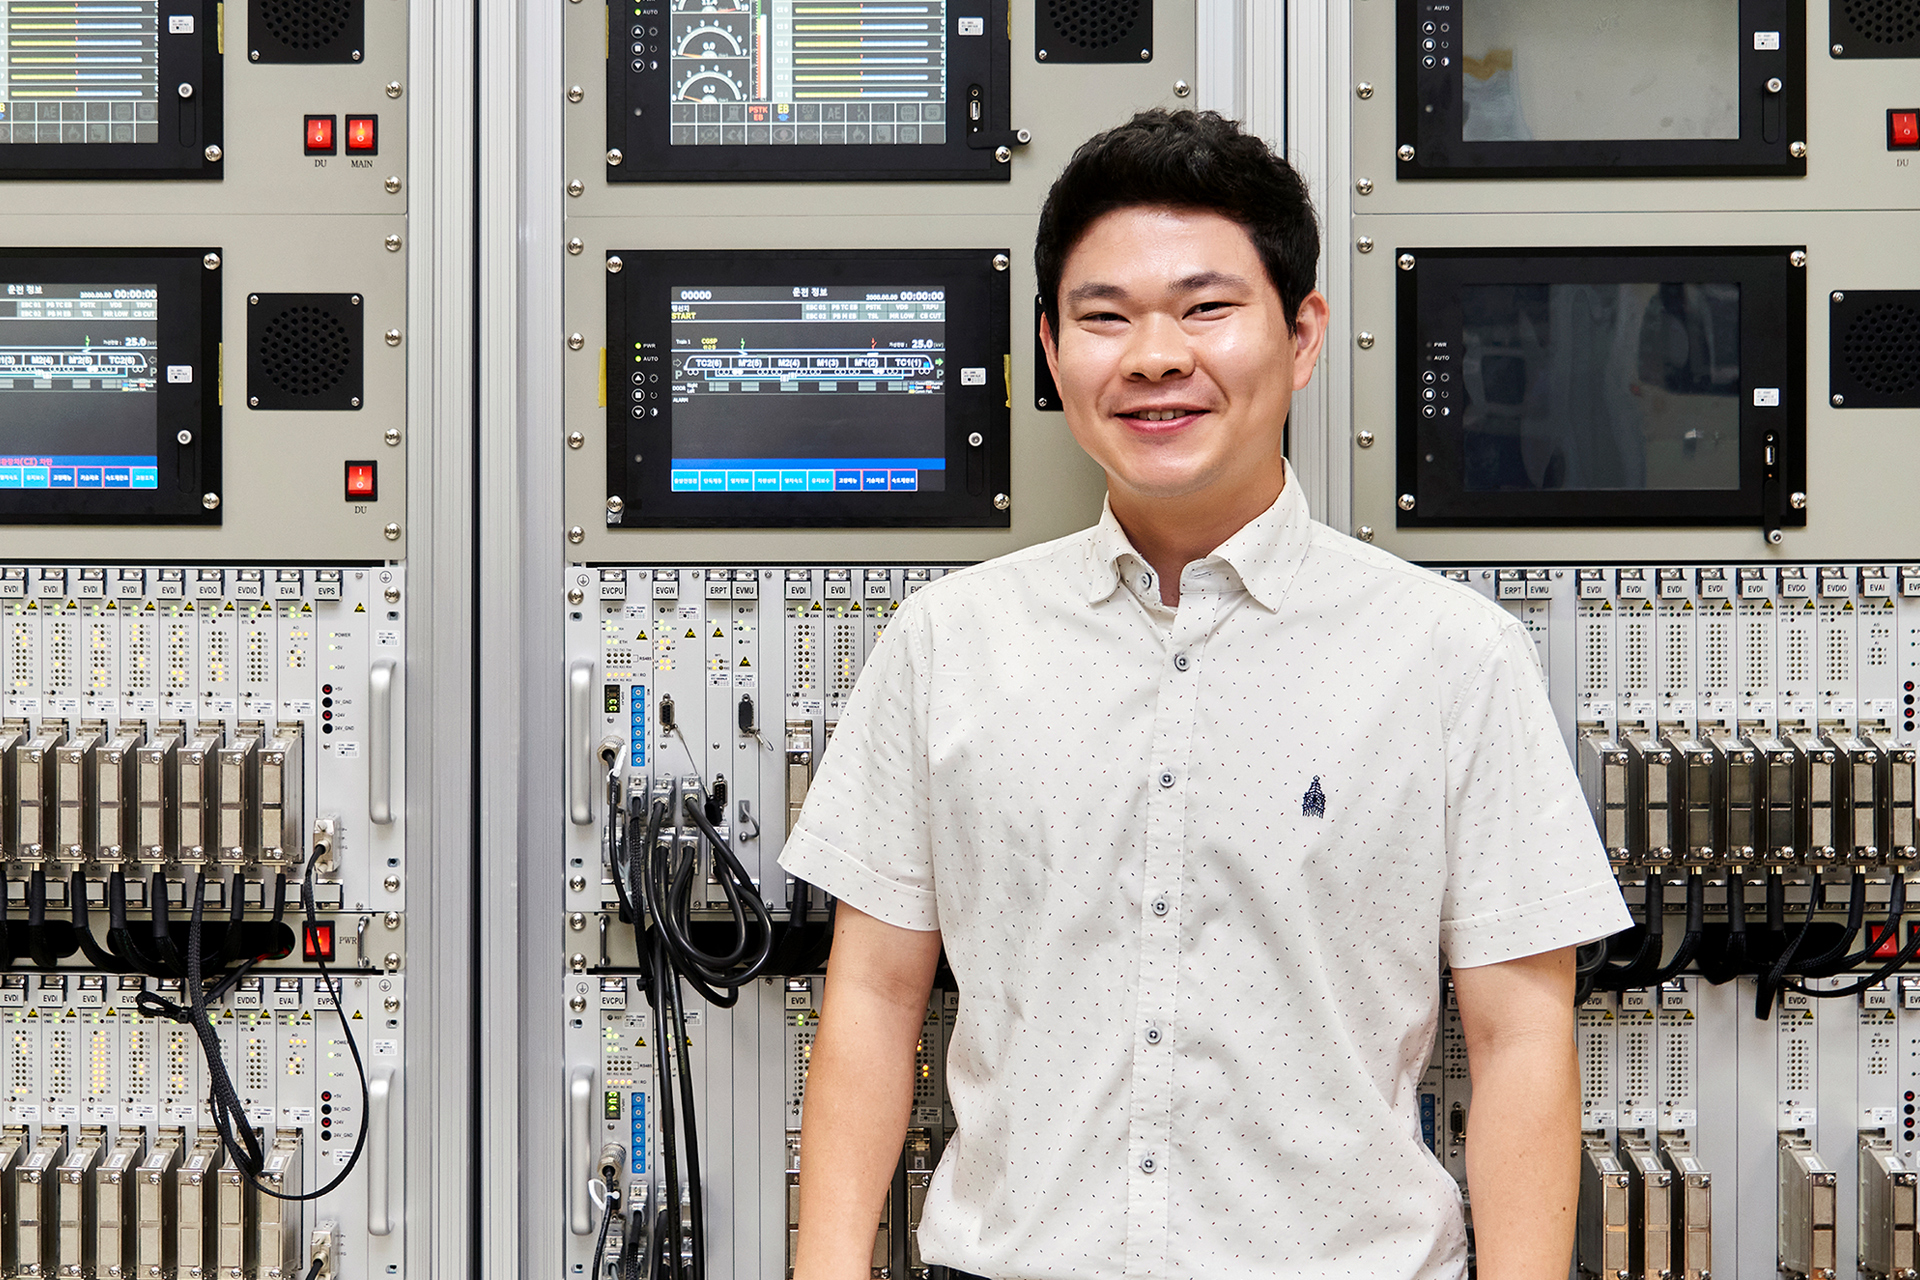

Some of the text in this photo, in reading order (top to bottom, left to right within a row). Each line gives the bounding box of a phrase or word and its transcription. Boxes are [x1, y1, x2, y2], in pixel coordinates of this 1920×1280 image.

[748, 106, 768, 114] PSTK
[777, 104, 789, 114] EB
[314, 159, 326, 168] DU
[351, 160, 373, 168] MAIN
[1897, 158, 1909, 167] DU
[113, 289, 157, 299] 00:00:00
[681, 290, 712, 300] 00000
[900, 291, 944, 301] 00:00:00
[124, 337, 147, 347] 25.0
[911, 339, 933, 349] 25.0
[675, 370, 683, 380] P
[936, 370, 944, 379] P
[354, 506, 367, 515] DU
[237, 586, 258, 594] EVDIO
[280, 587, 295, 595] EVAI
[318, 587, 335, 595] EVPS
[601, 587, 624, 595] EVCPU
[1504, 587, 1522, 595] ERPT
[1530, 586, 1549, 594] EVMU
[1586, 586, 1602, 594] EVDI
[1626, 586, 1641, 594] EVDI
[1708, 584, 1723, 593] EVDI
[1748, 585, 1763, 593] EVDI
[1787, 584, 1806, 592] EVDO
[1827, 584, 1849, 592] EVDIO
[602, 997, 624, 1005] EVCPU
[1870, 996, 1885, 1004] EVAI
